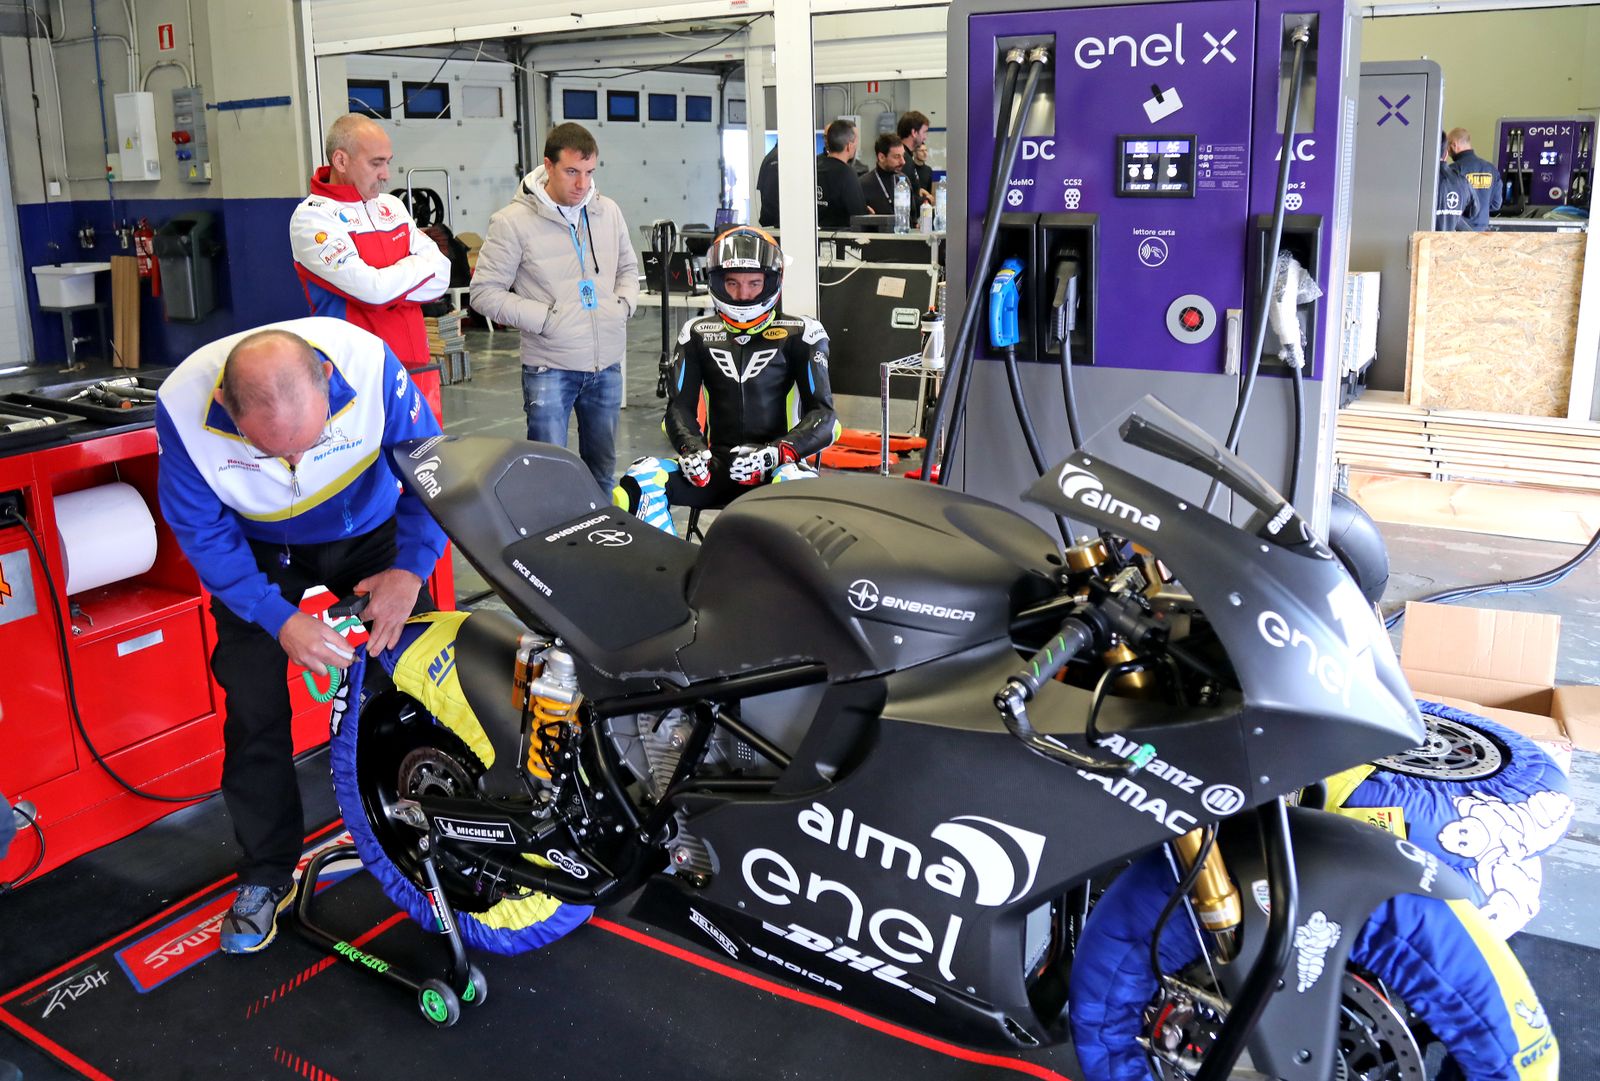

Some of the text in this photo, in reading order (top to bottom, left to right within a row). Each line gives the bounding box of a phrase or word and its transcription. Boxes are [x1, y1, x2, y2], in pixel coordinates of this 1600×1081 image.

[1074, 22, 1185, 69] enel
[1528, 125, 1558, 136] enel
[1022, 140, 1056, 160] DC
[1008, 178, 1034, 186] AdeMO
[1063, 178, 1082, 186] CCS2
[1300, 181, 1306, 189] 2
[1133, 228, 1156, 236] lettore
[313, 439, 363, 462] MICHELIN
[416, 470, 442, 499] alma
[1081, 488, 1161, 532] alma
[545, 514, 610, 543] ENERGICA
[512, 559, 552, 597] RACE SEATS
[881, 595, 976, 622] ENERGICA
[1096, 733, 1203, 794] Alanz
[1060, 752, 1198, 835] AMAC
[456, 825, 505, 838] MICHELIN
[797, 801, 966, 899] alma
[741, 847, 963, 982] enel
[144, 919, 223, 969] AMAC
[785, 923, 912, 991] DHL
[751, 945, 843, 991] ERGICA
